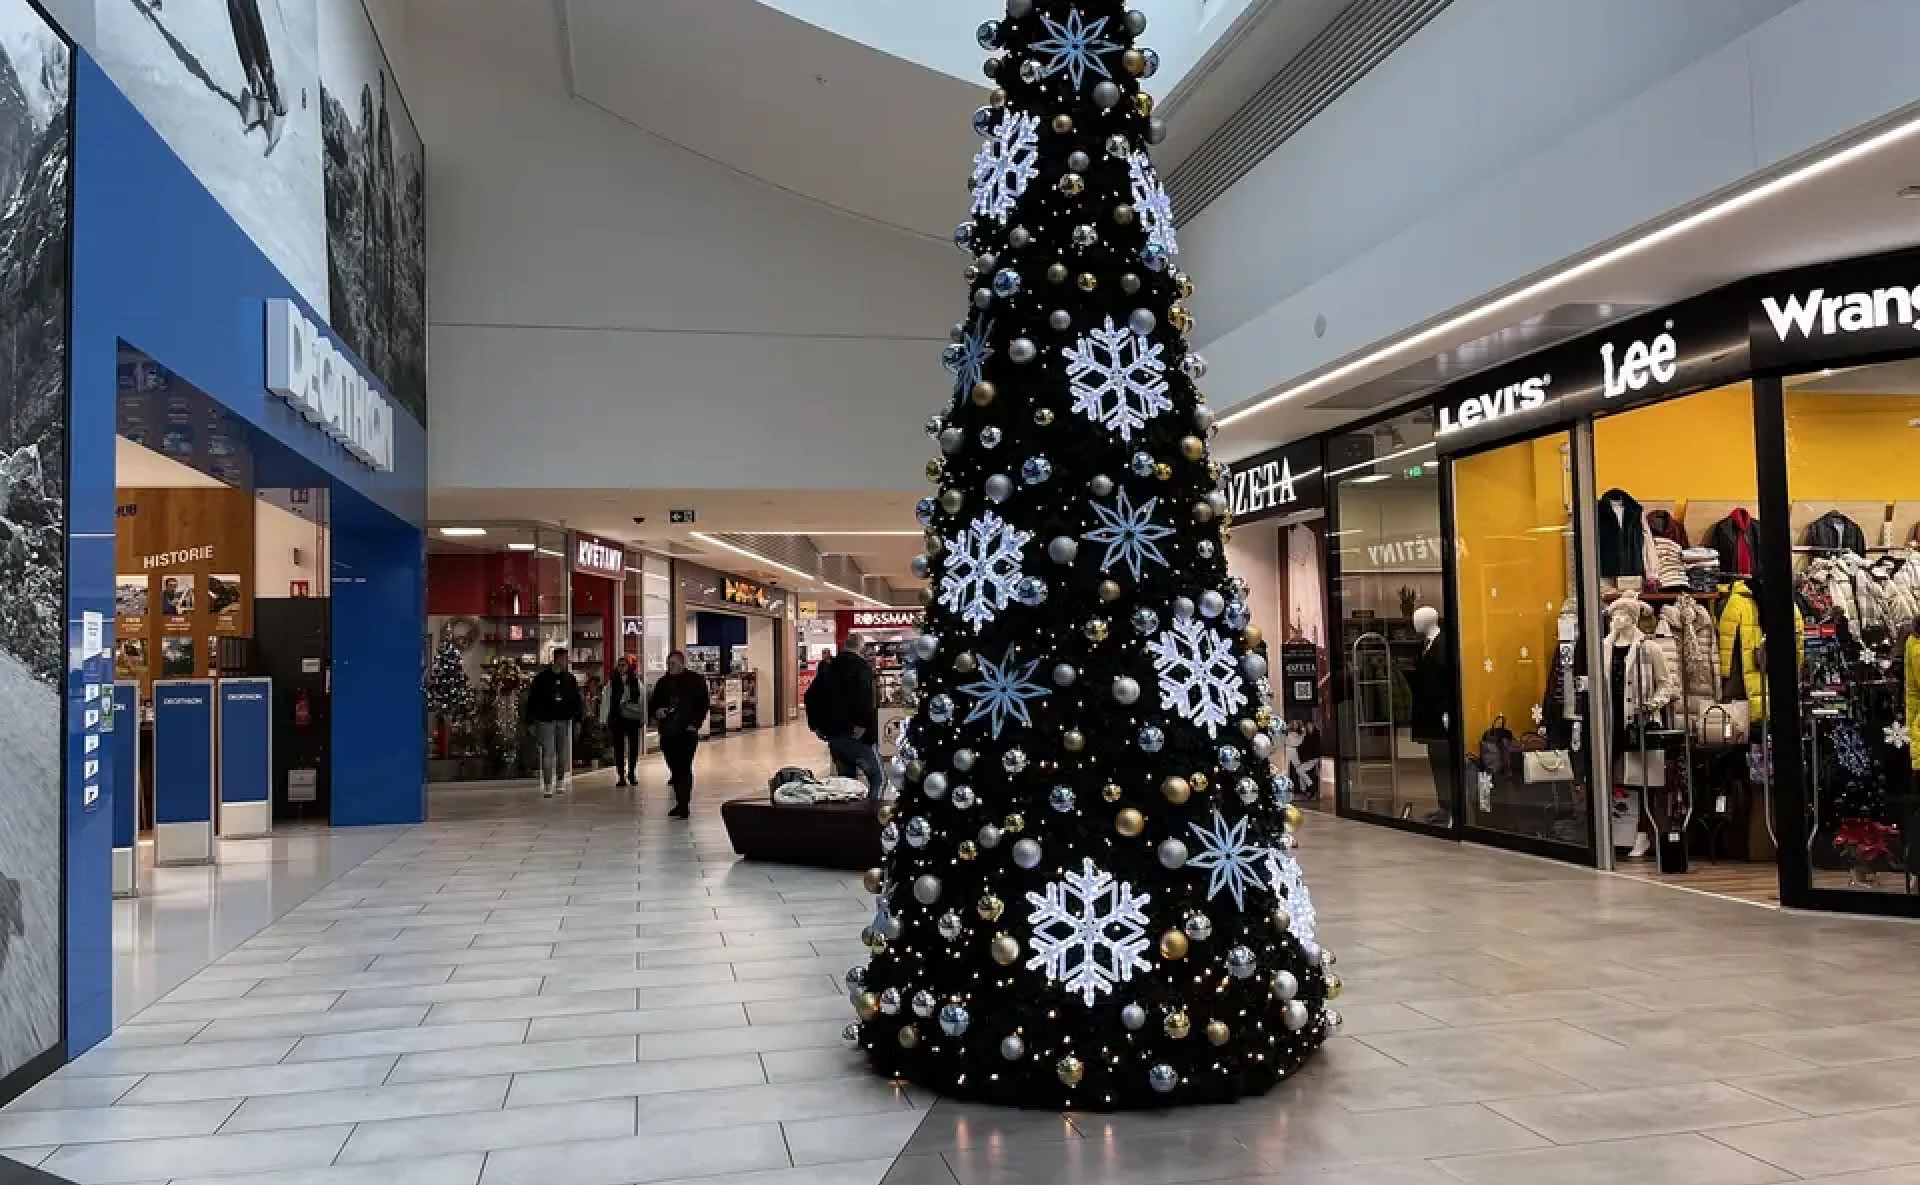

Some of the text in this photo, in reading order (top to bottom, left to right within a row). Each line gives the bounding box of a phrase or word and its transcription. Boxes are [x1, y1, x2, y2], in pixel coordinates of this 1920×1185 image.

[1600, 332, 1677, 398] Lee
[1439, 377, 1547, 433] Levi's
[1228, 456, 1297, 515] ZETA
[143, 545, 214, 569] HISTORIE
